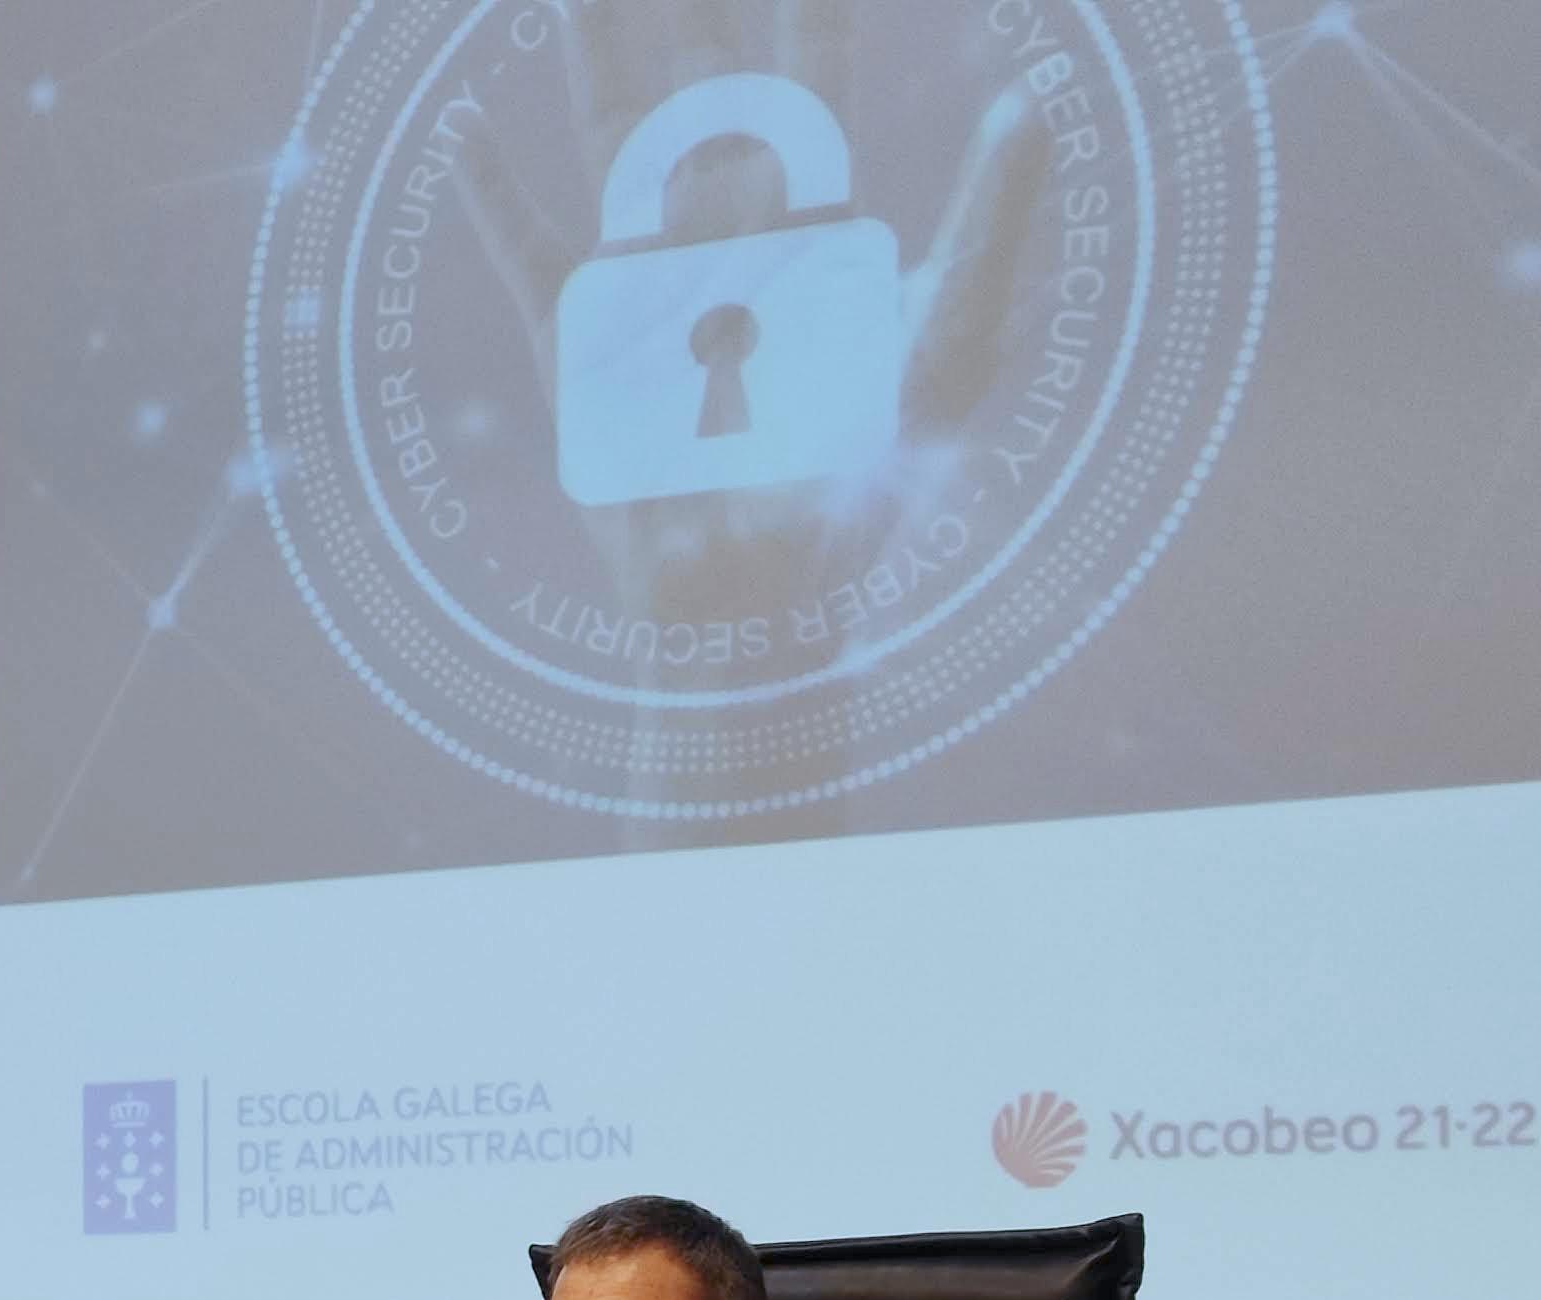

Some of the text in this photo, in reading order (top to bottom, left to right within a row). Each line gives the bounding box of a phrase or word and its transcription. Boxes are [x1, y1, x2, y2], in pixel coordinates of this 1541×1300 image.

[988, 0, 1110, 484] CYBER SECURITY
[375, 80, 484, 538] CYBER SECURITY
[509, 515, 969, 665] CYBER SECURITY
[237, 1080, 553, 1128] ESCOLA GALEGA
[1108, 1104, 1379, 1160] Xacobeo
[237, 1116, 634, 1175] DE ADMINISTRACIÓN
[237, 1176, 395, 1220] PÚBLICA
